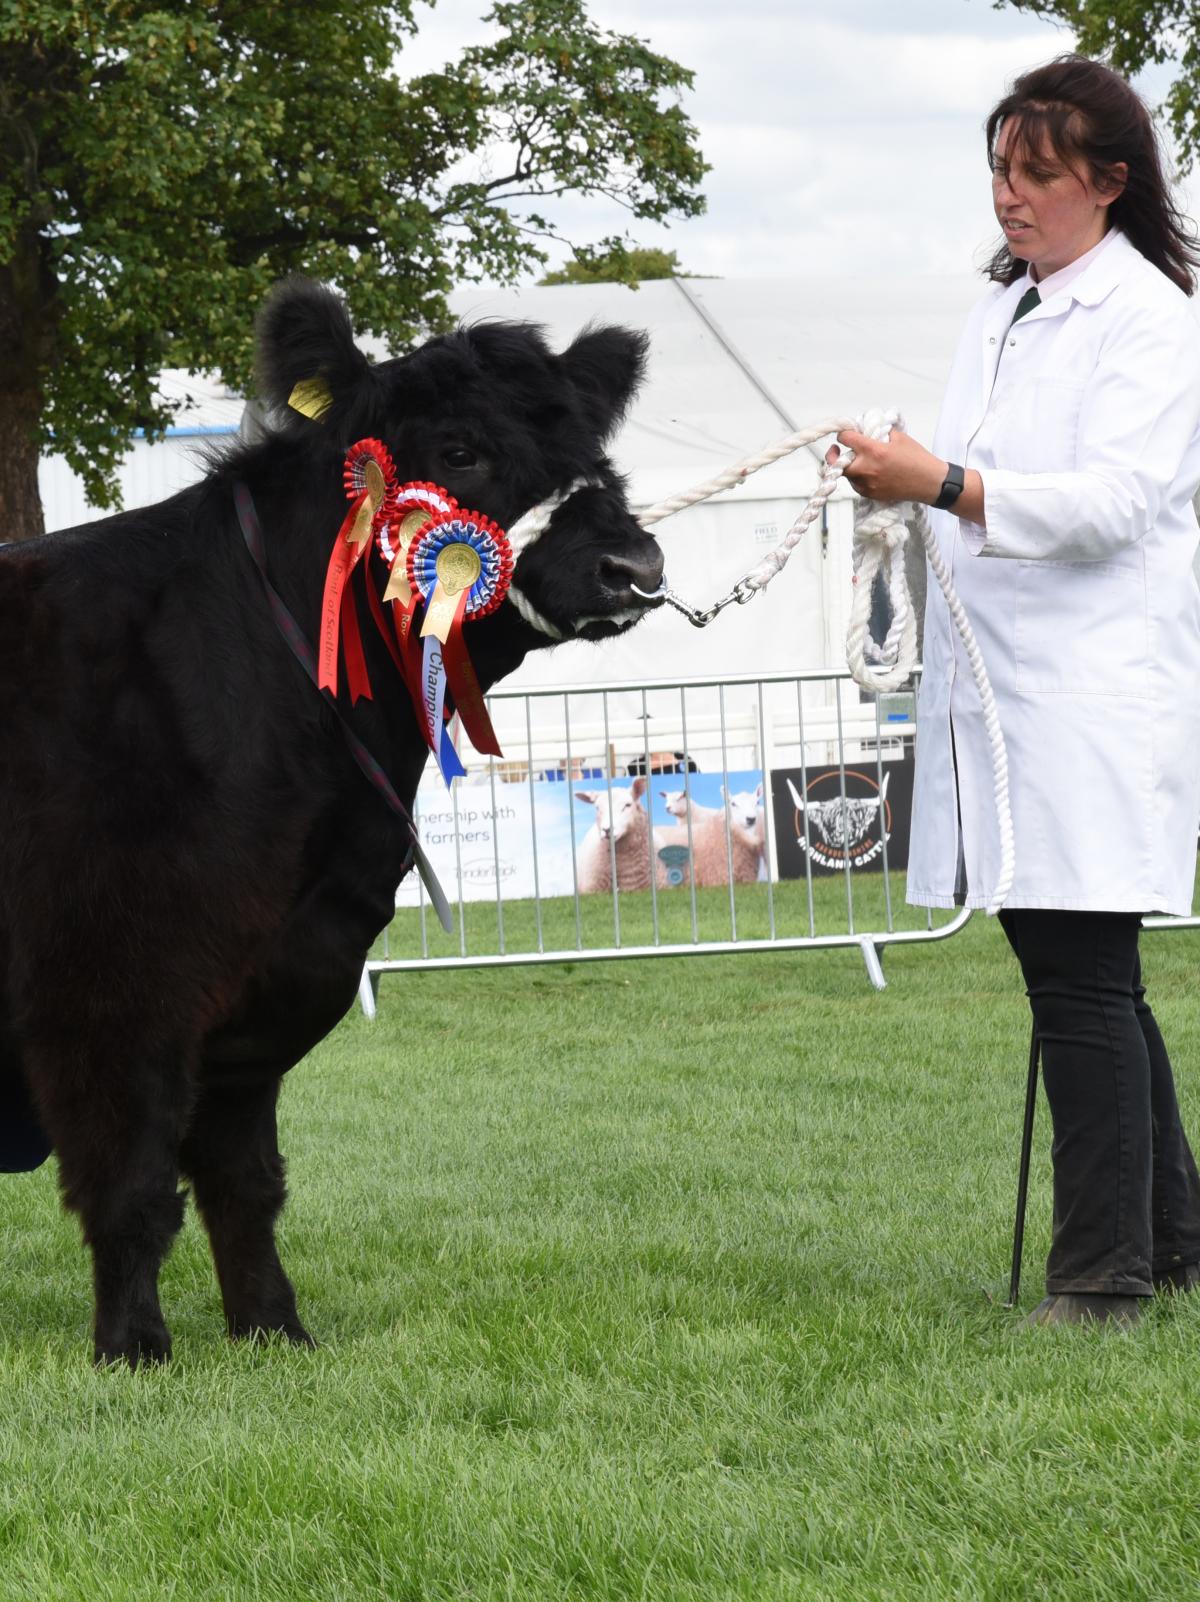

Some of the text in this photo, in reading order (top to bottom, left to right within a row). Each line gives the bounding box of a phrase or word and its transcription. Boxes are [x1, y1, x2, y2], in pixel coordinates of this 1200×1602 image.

[425, 651, 443, 737] Champion
[417, 808, 479, 825] nership
[425, 830, 491, 845] farmers
[854, 832, 891, 867] CATTE
